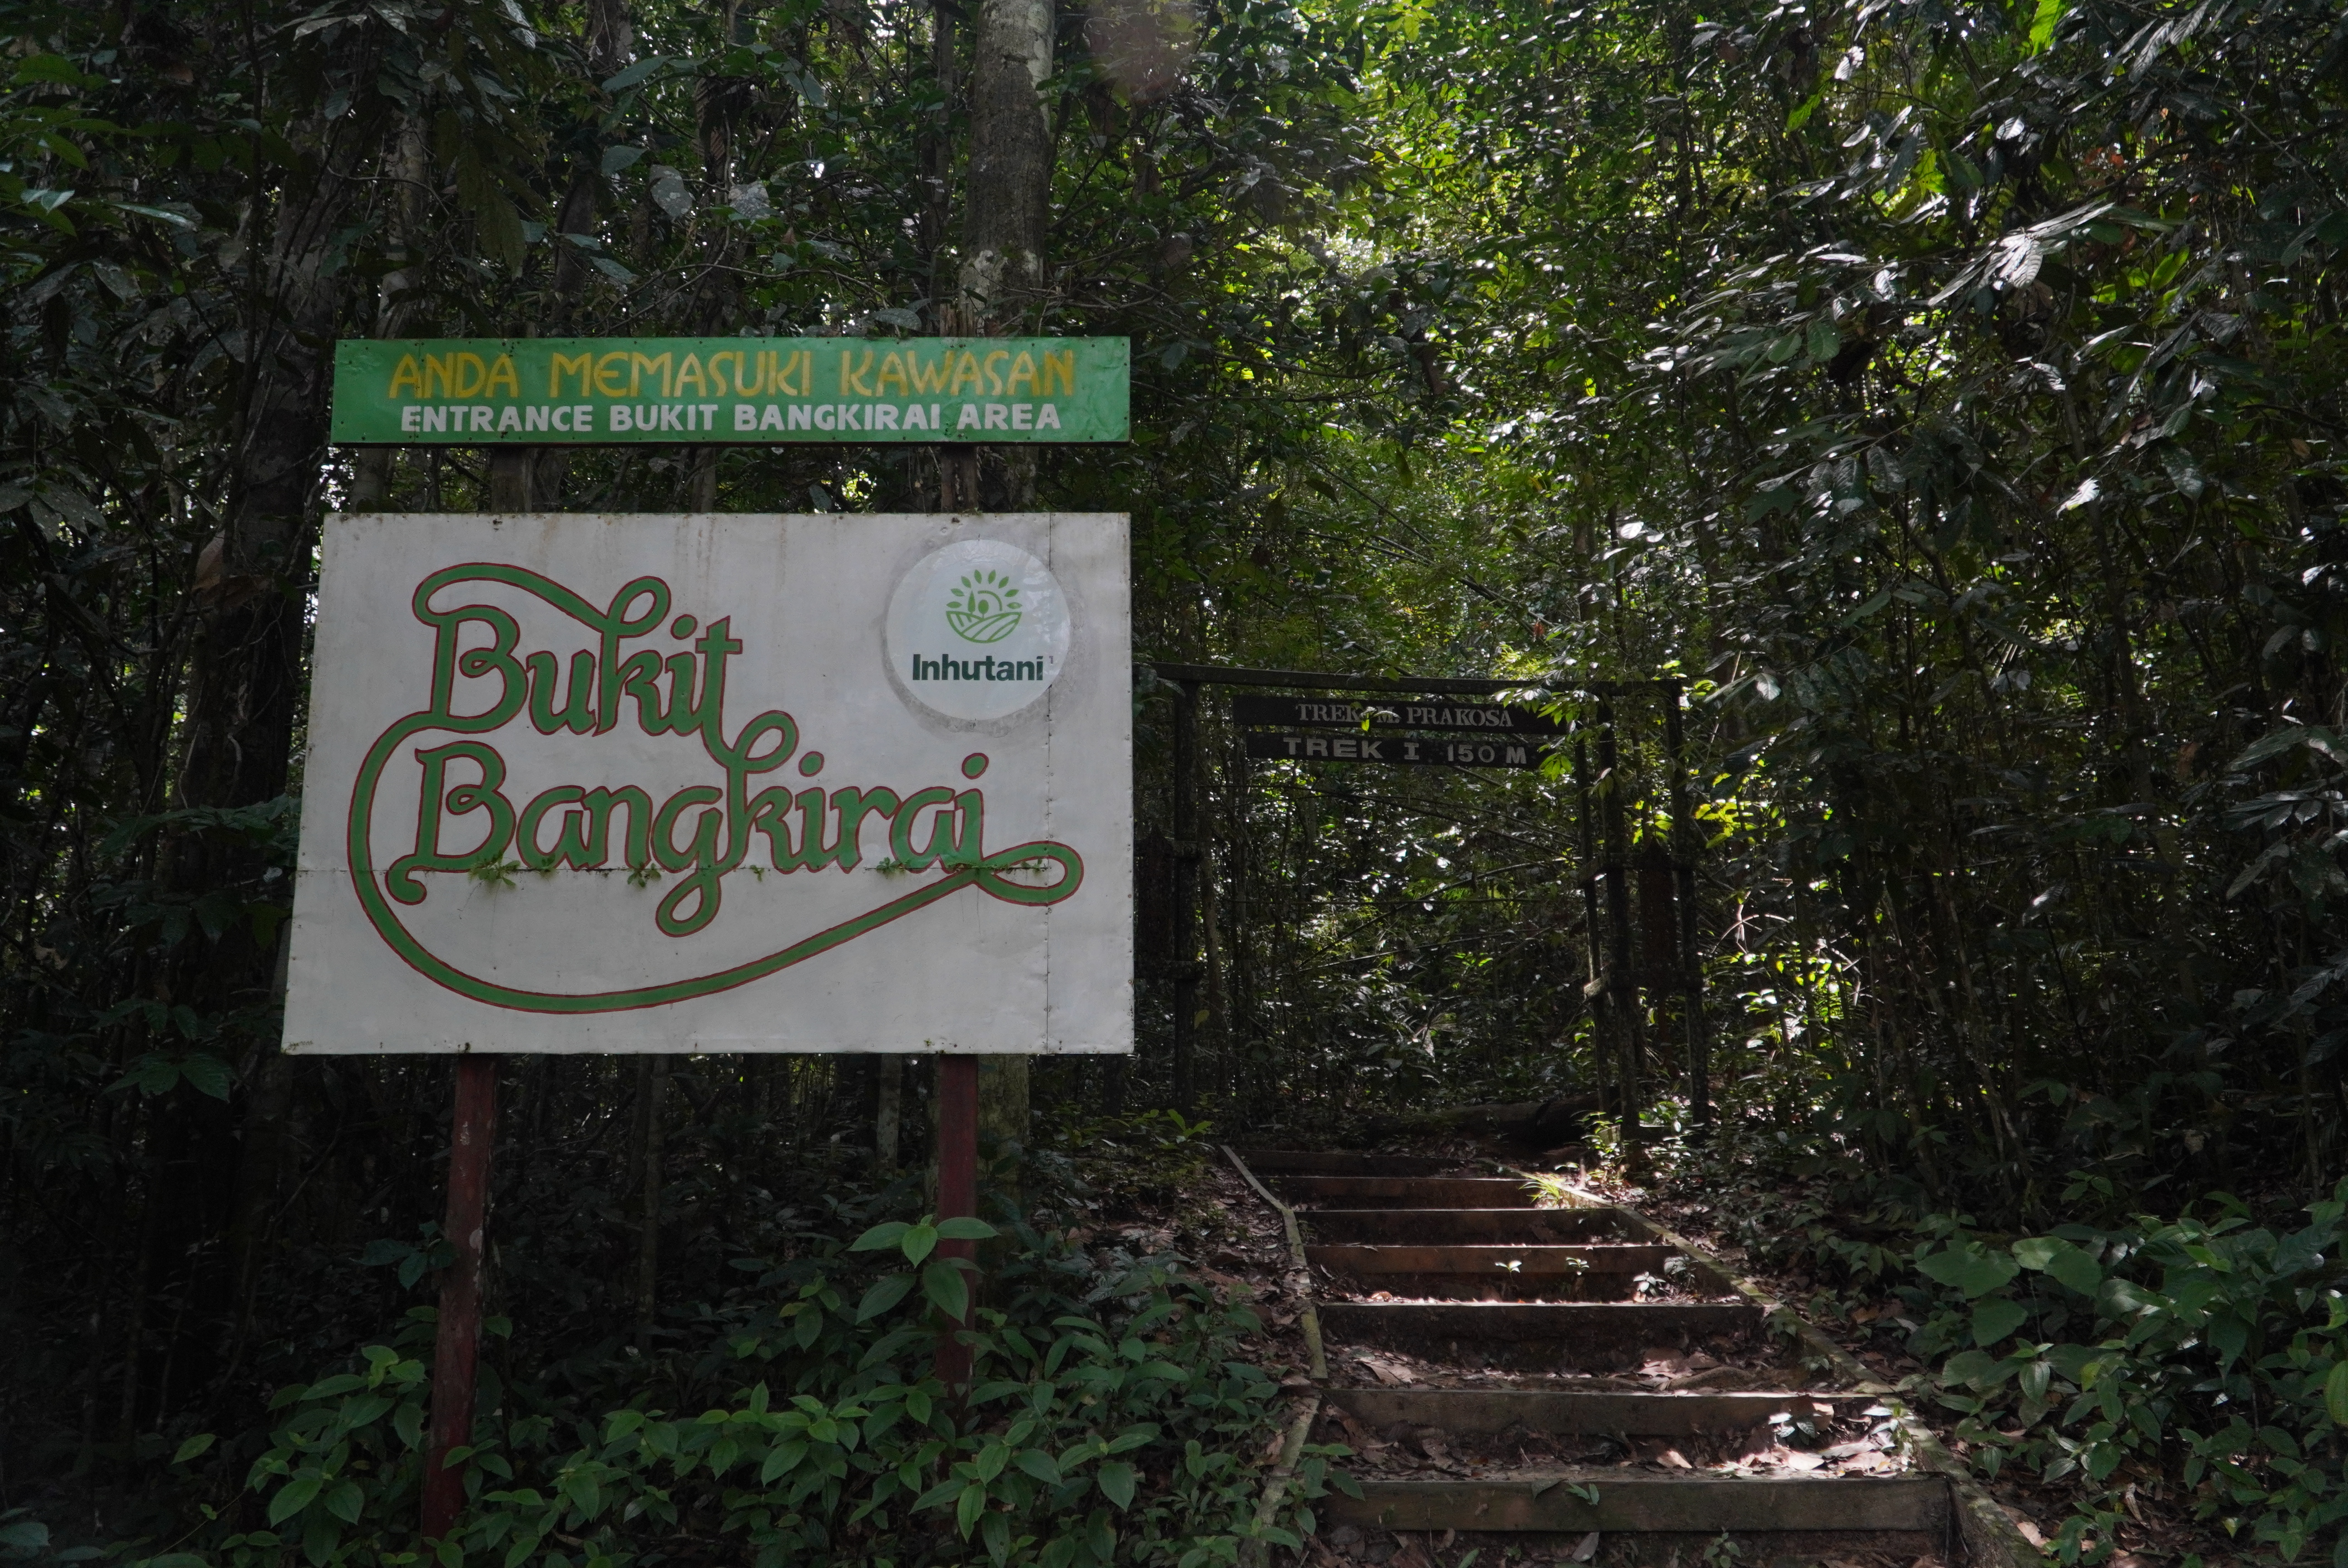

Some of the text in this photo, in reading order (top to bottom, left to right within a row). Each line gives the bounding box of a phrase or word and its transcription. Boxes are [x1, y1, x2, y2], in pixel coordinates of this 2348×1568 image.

[389, 349, 1075, 399] ANDA MEMASUKI KAWASAN
[400, 403, 1062, 432] ENTRANCE BUKIT BANGKIRAI AREA
[412, 561, 743, 737] Bukit
[912, 653, 1044, 682] Inhutani
[1407, 706, 1515, 728] PRAKOSA
[1283, 737, 1383, 759] TREK
[1447, 743, 1496, 764] 150
[1506, 746, 1527, 765] M
[387, 710, 1083, 937] Bangkirai
